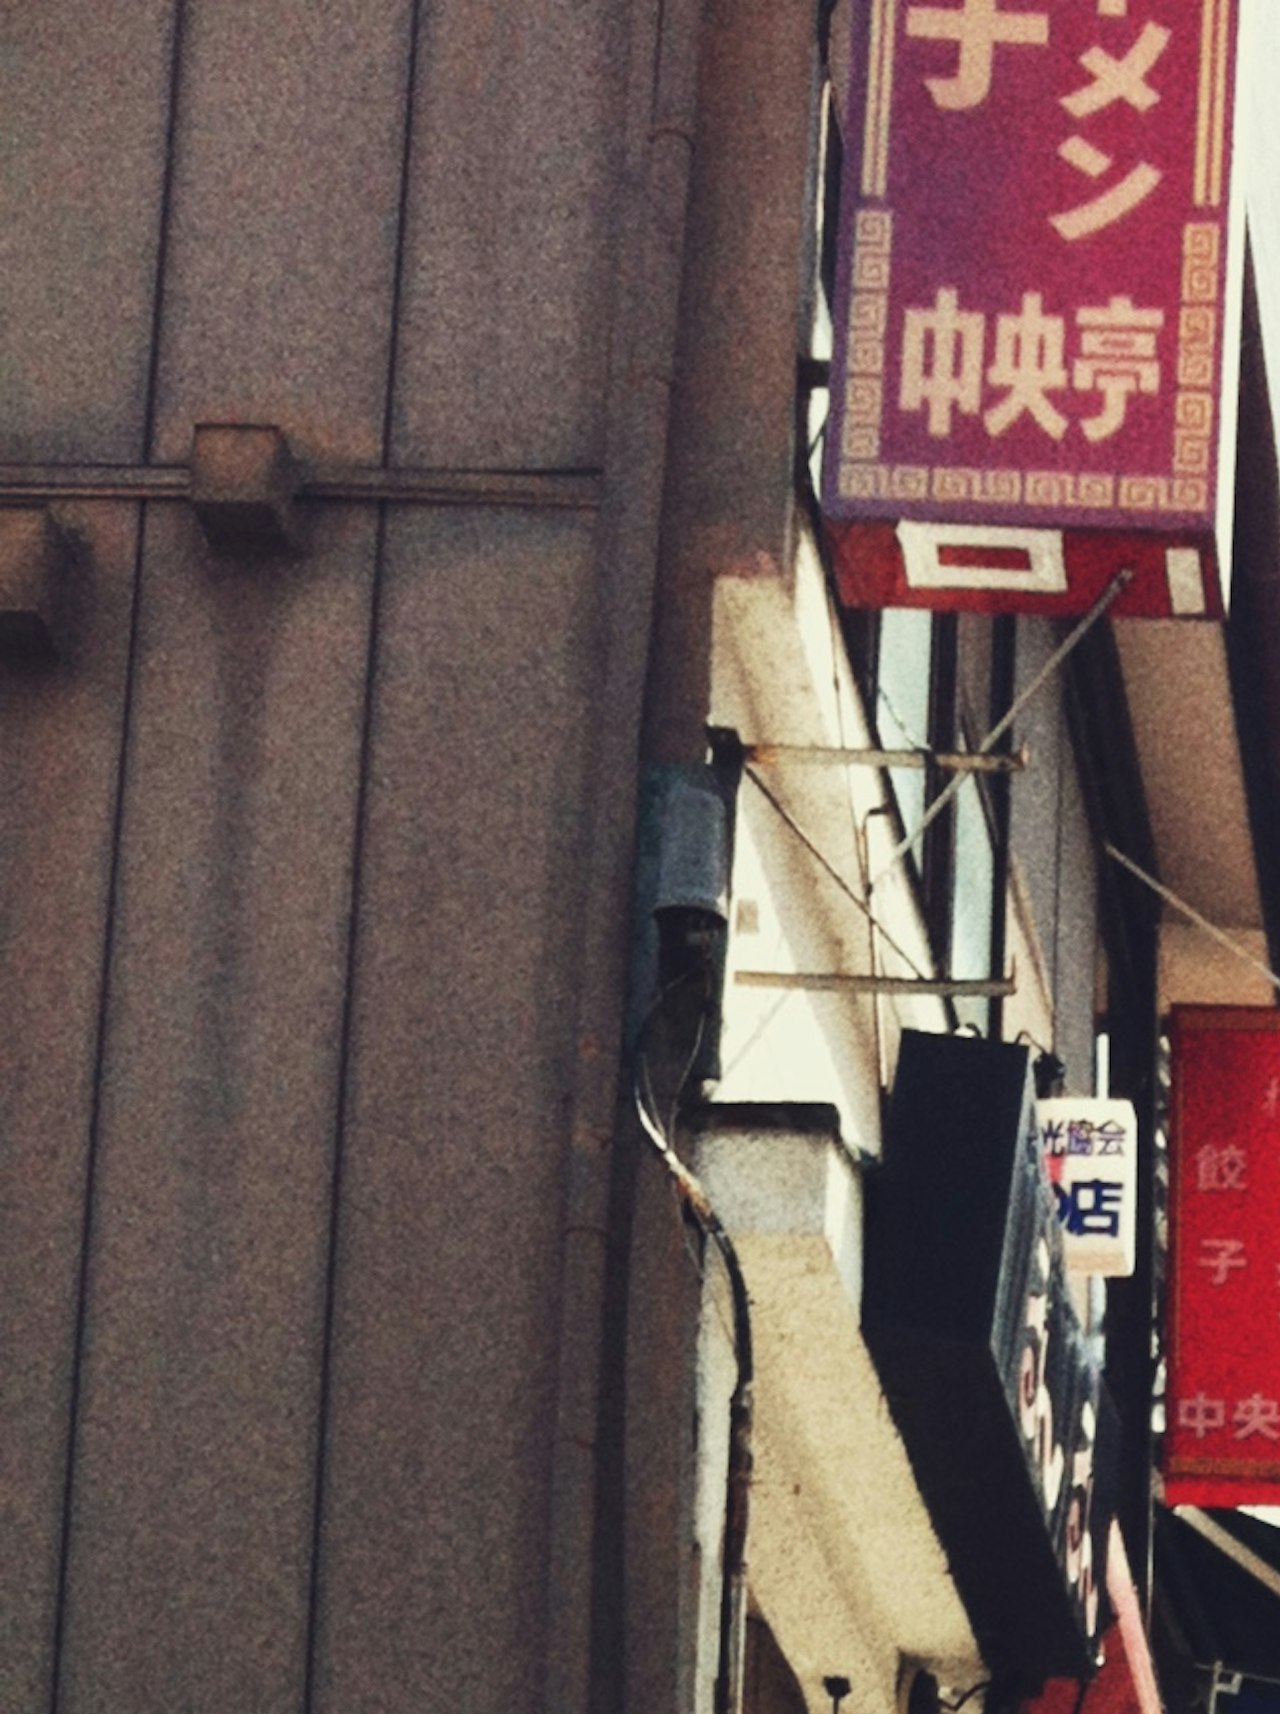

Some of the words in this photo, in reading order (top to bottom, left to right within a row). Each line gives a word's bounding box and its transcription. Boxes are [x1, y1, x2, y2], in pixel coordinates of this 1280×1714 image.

[1048, 0, 1172, 241] メン
[897, 287, 1165, 443] 中央亭
[1052, 1178, 1124, 1238] 店
[1195, 1143, 1248, 1286] 餃子
